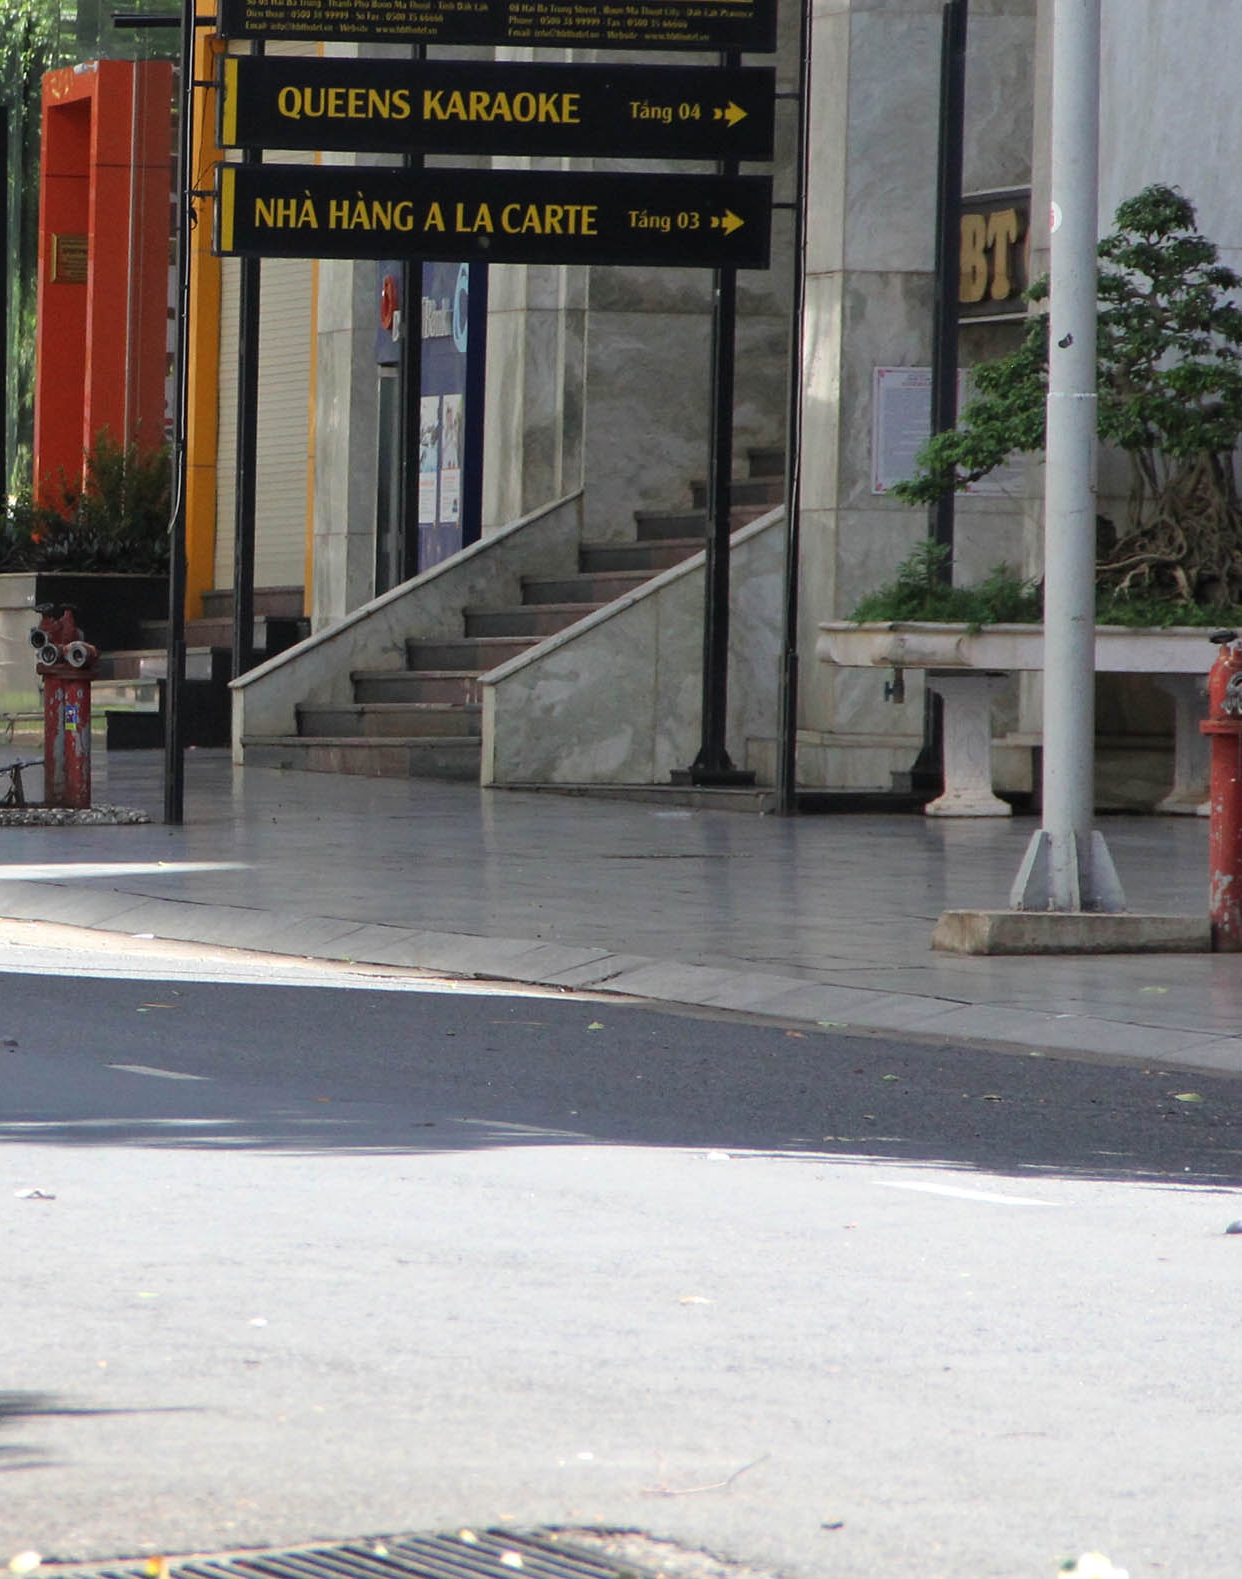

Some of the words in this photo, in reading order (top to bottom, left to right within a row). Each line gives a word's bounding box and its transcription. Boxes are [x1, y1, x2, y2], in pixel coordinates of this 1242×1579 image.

[278, 86, 411, 120] QUEENS
[423, 90, 581, 124] KARAOKE
[679, 102, 701, 120] 04
[255, 189, 318, 228] NHÀ
[329, 191, 414, 231] HÀNG
[423, 202, 446, 232] A
[456, 203, 494, 233] LA
[501, 203, 598, 235] CARTE
[677, 212, 700, 229] 03
